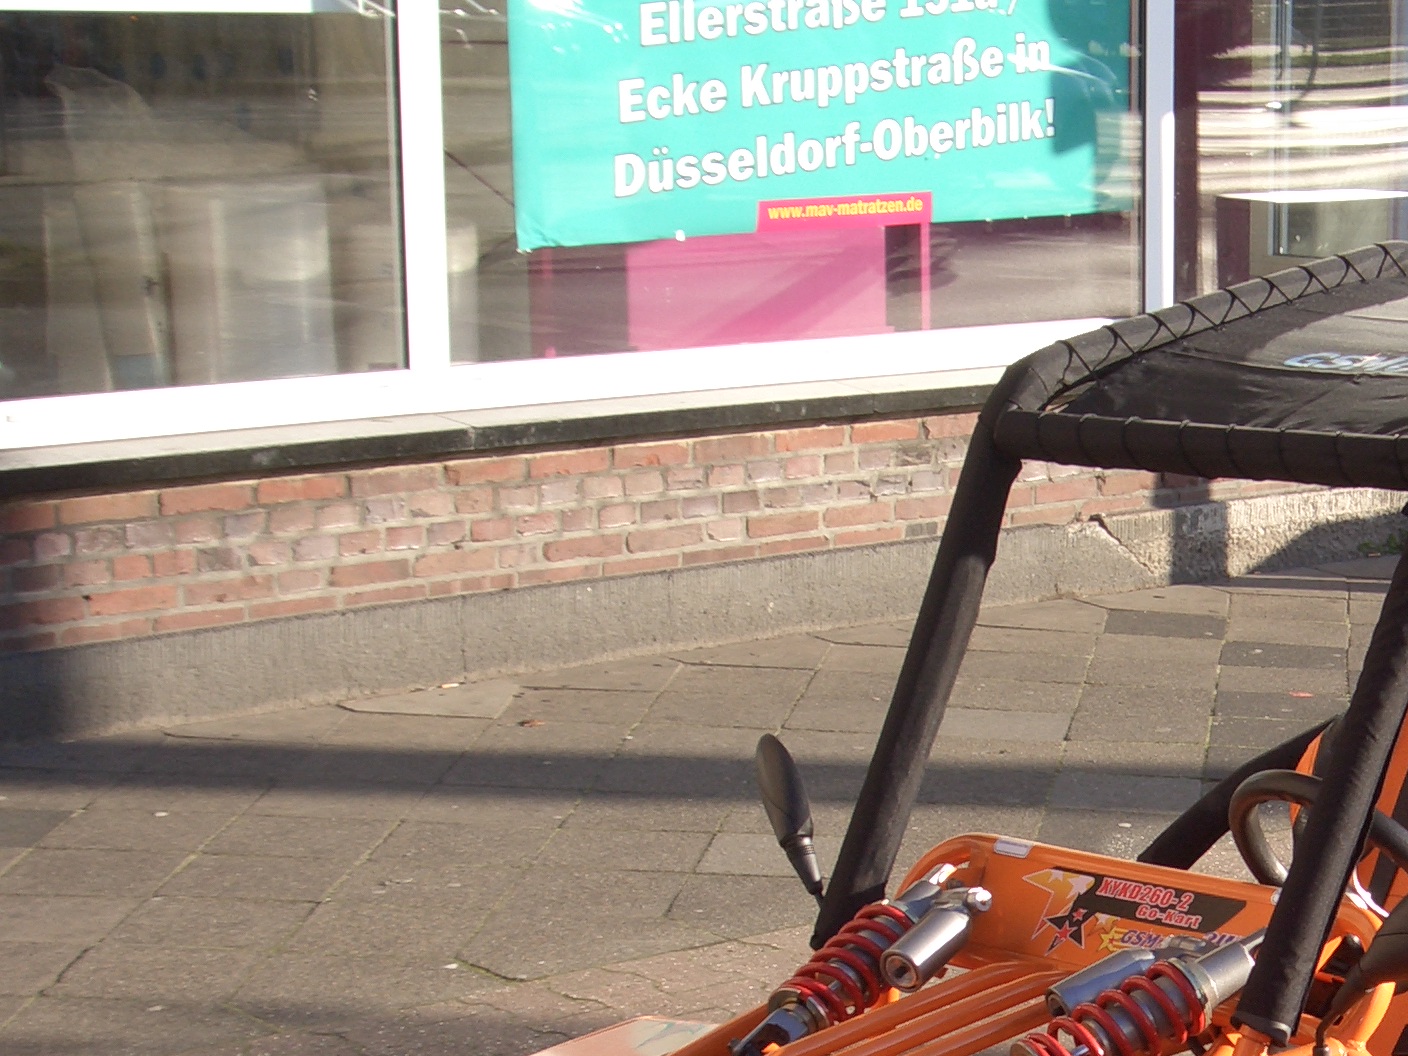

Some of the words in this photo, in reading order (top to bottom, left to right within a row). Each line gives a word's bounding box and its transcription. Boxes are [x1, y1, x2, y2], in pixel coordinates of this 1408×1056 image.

[640, 0, 886, 46] Ellerstraße
[618, 76, 728, 124] Ecke
[741, 34, 1004, 108] Kruppstraße
[1014, 32, 1051, 74] in
[614, 97, 1056, 198] Düsseldorf-Oberbilk!
[767, 195, 924, 221] www.mav-matratzen.de
[1096, 877, 1194, 912] XYKD260-2
[1136, 904, 1203, 929] Go-Kart
